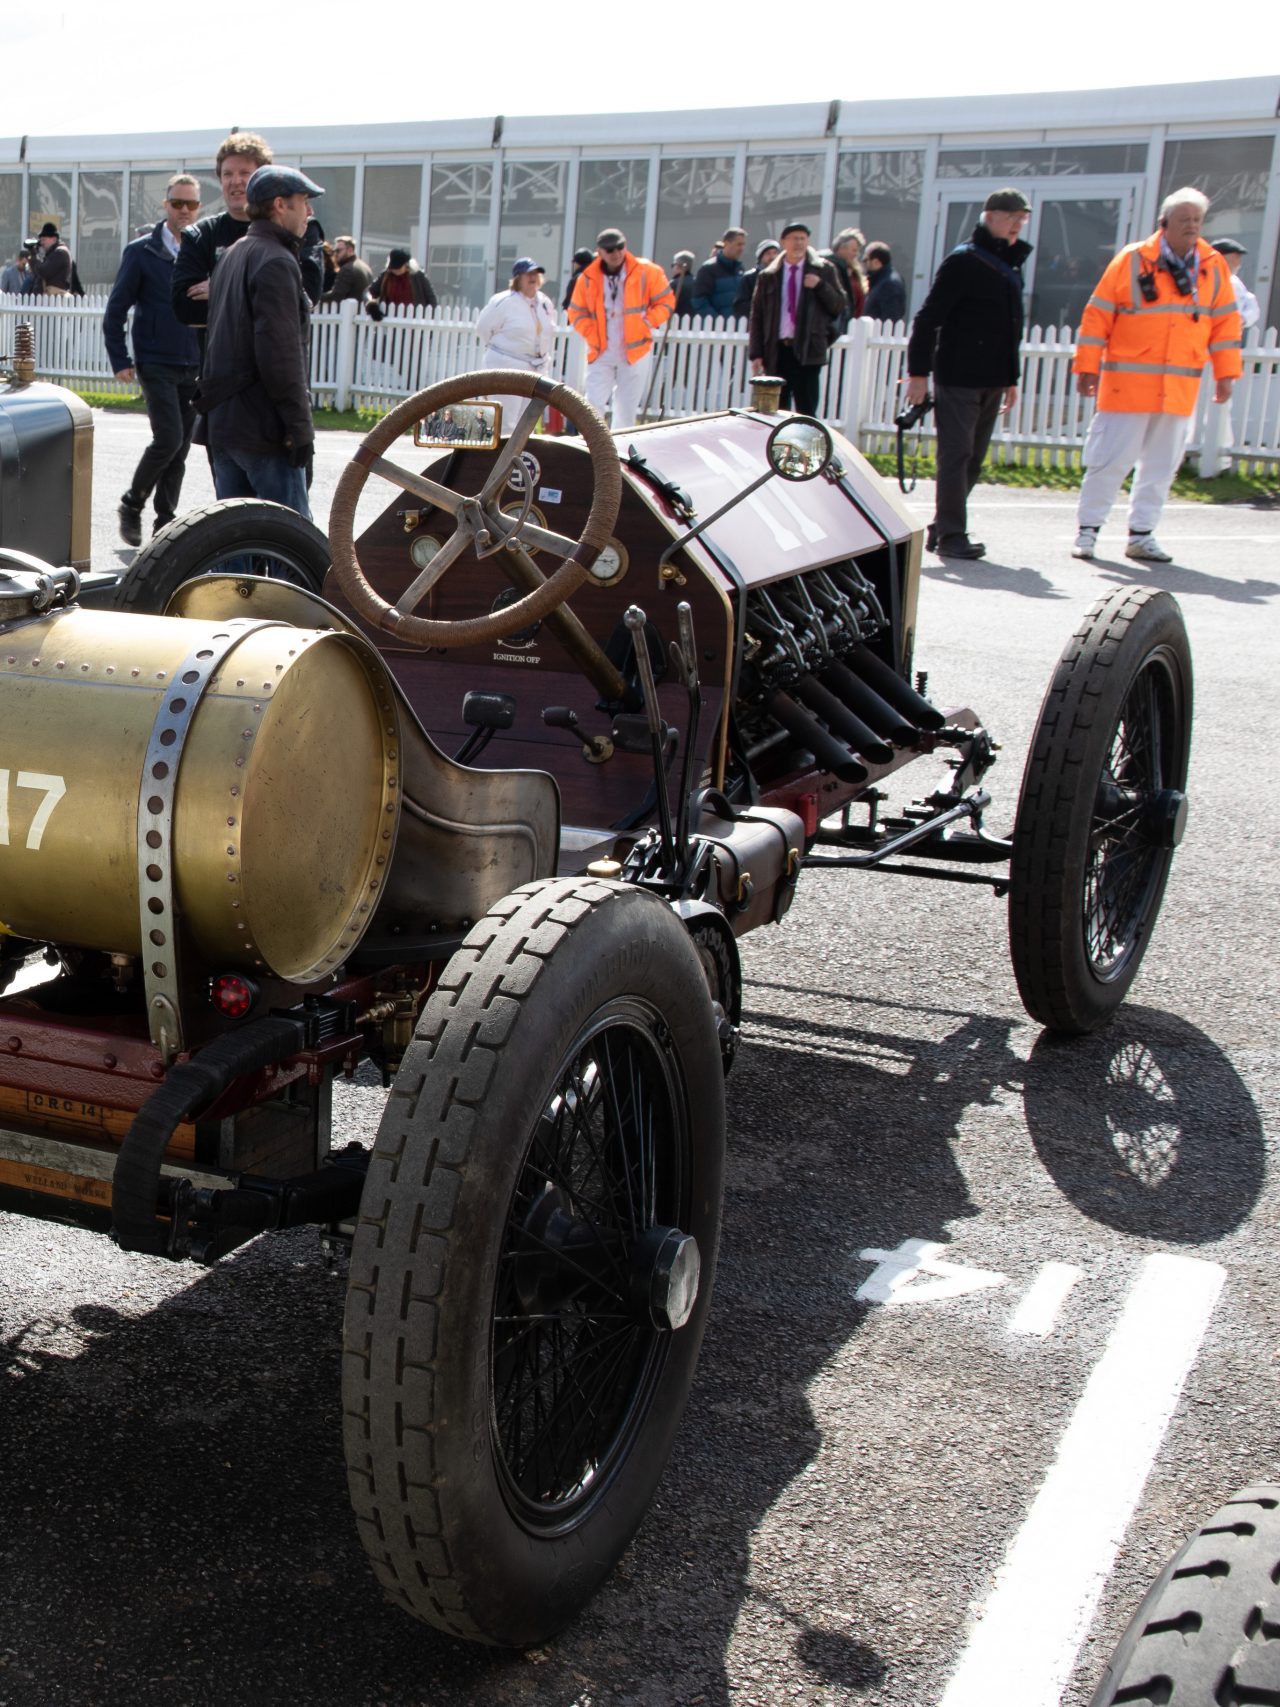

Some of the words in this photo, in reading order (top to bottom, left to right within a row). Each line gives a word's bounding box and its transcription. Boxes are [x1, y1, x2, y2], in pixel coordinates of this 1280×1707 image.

[689, 438, 828, 552] 11
[493, 653, 525, 662] IGNITION
[81, 1104, 95, 1116] 14
